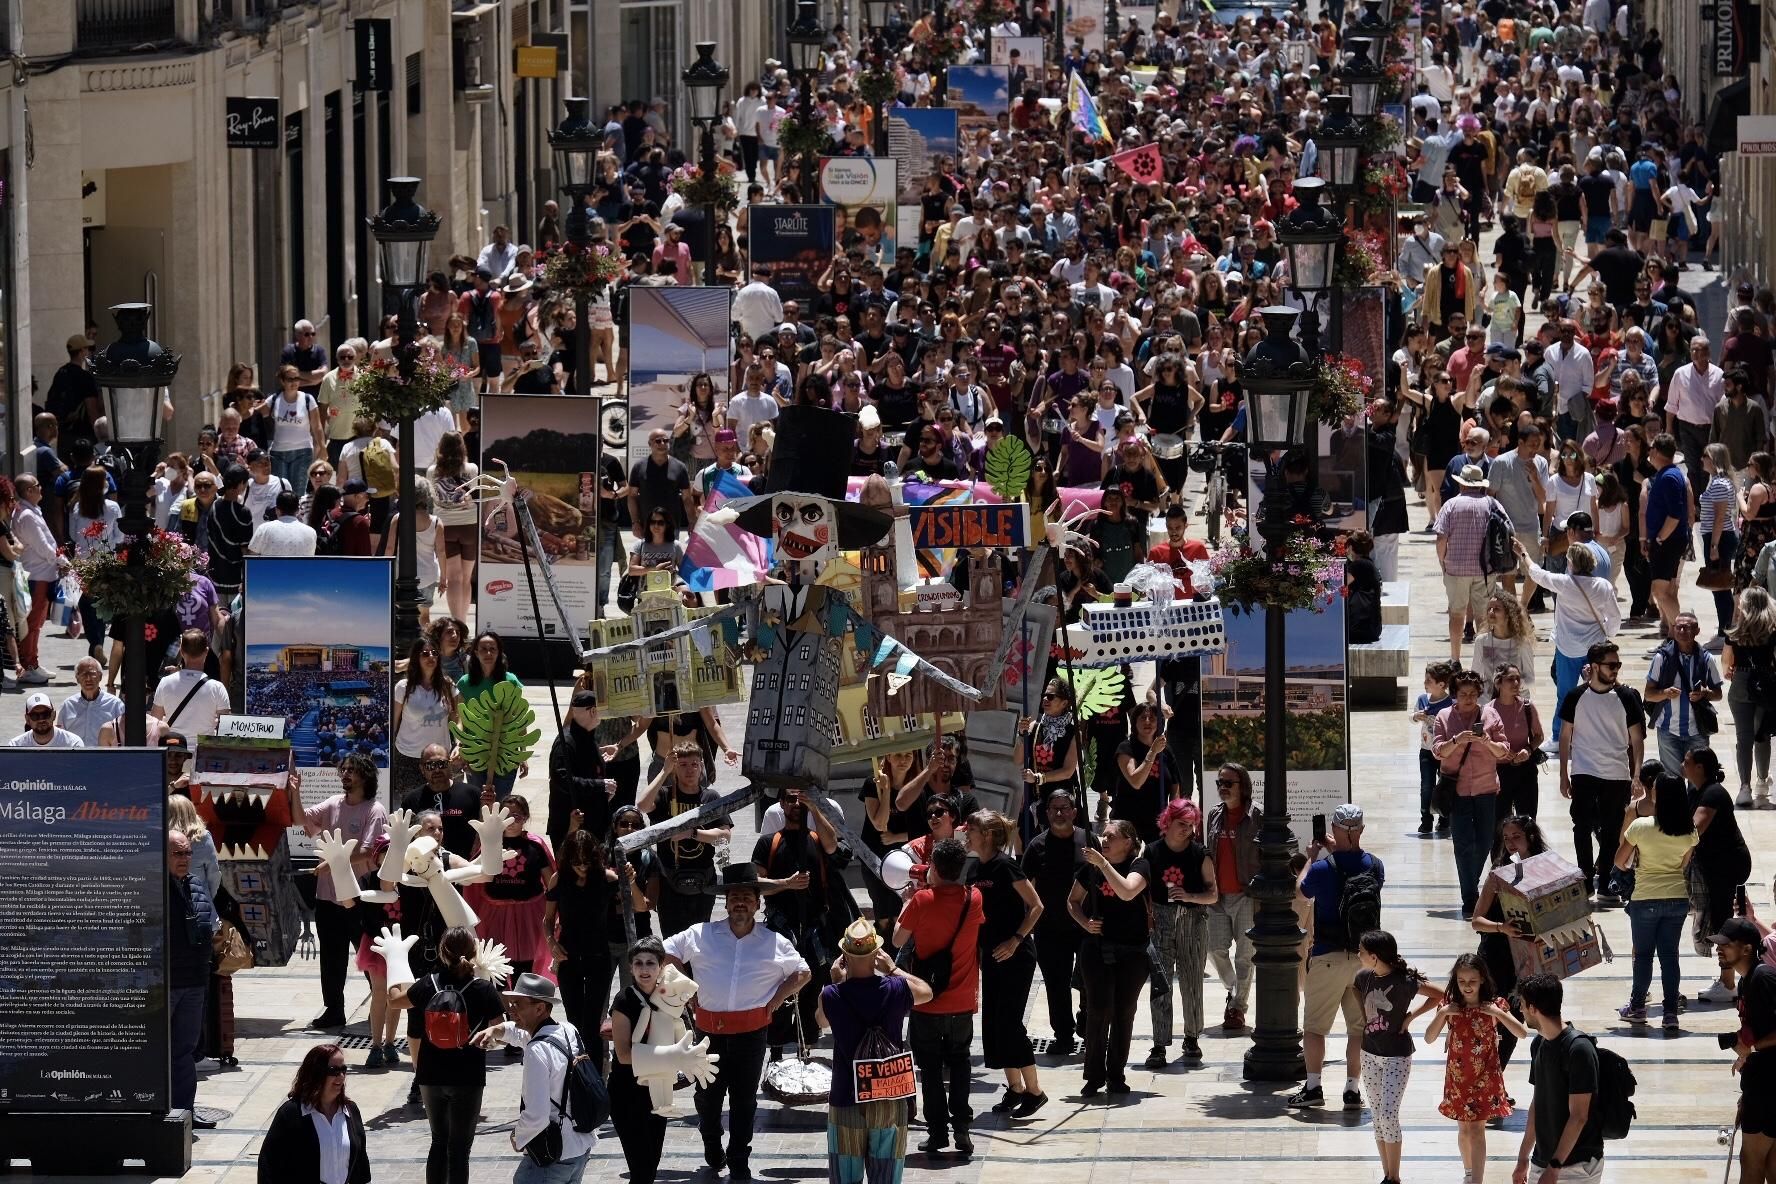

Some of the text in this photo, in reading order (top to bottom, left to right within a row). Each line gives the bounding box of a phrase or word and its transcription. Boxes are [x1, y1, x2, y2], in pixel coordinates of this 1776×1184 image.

[227, 106, 275, 136] Ray-Ban
[774, 218, 808, 230] STARLITE
[917, 592, 960, 601] CROWDFUNDING
[231, 721, 274, 733] MONSTRUO
[0, 800, 150, 824] Málaga Abierta
[858, 1057, 912, 1078] SE VENDE
[51, 1070, 86, 1080] Opinión
